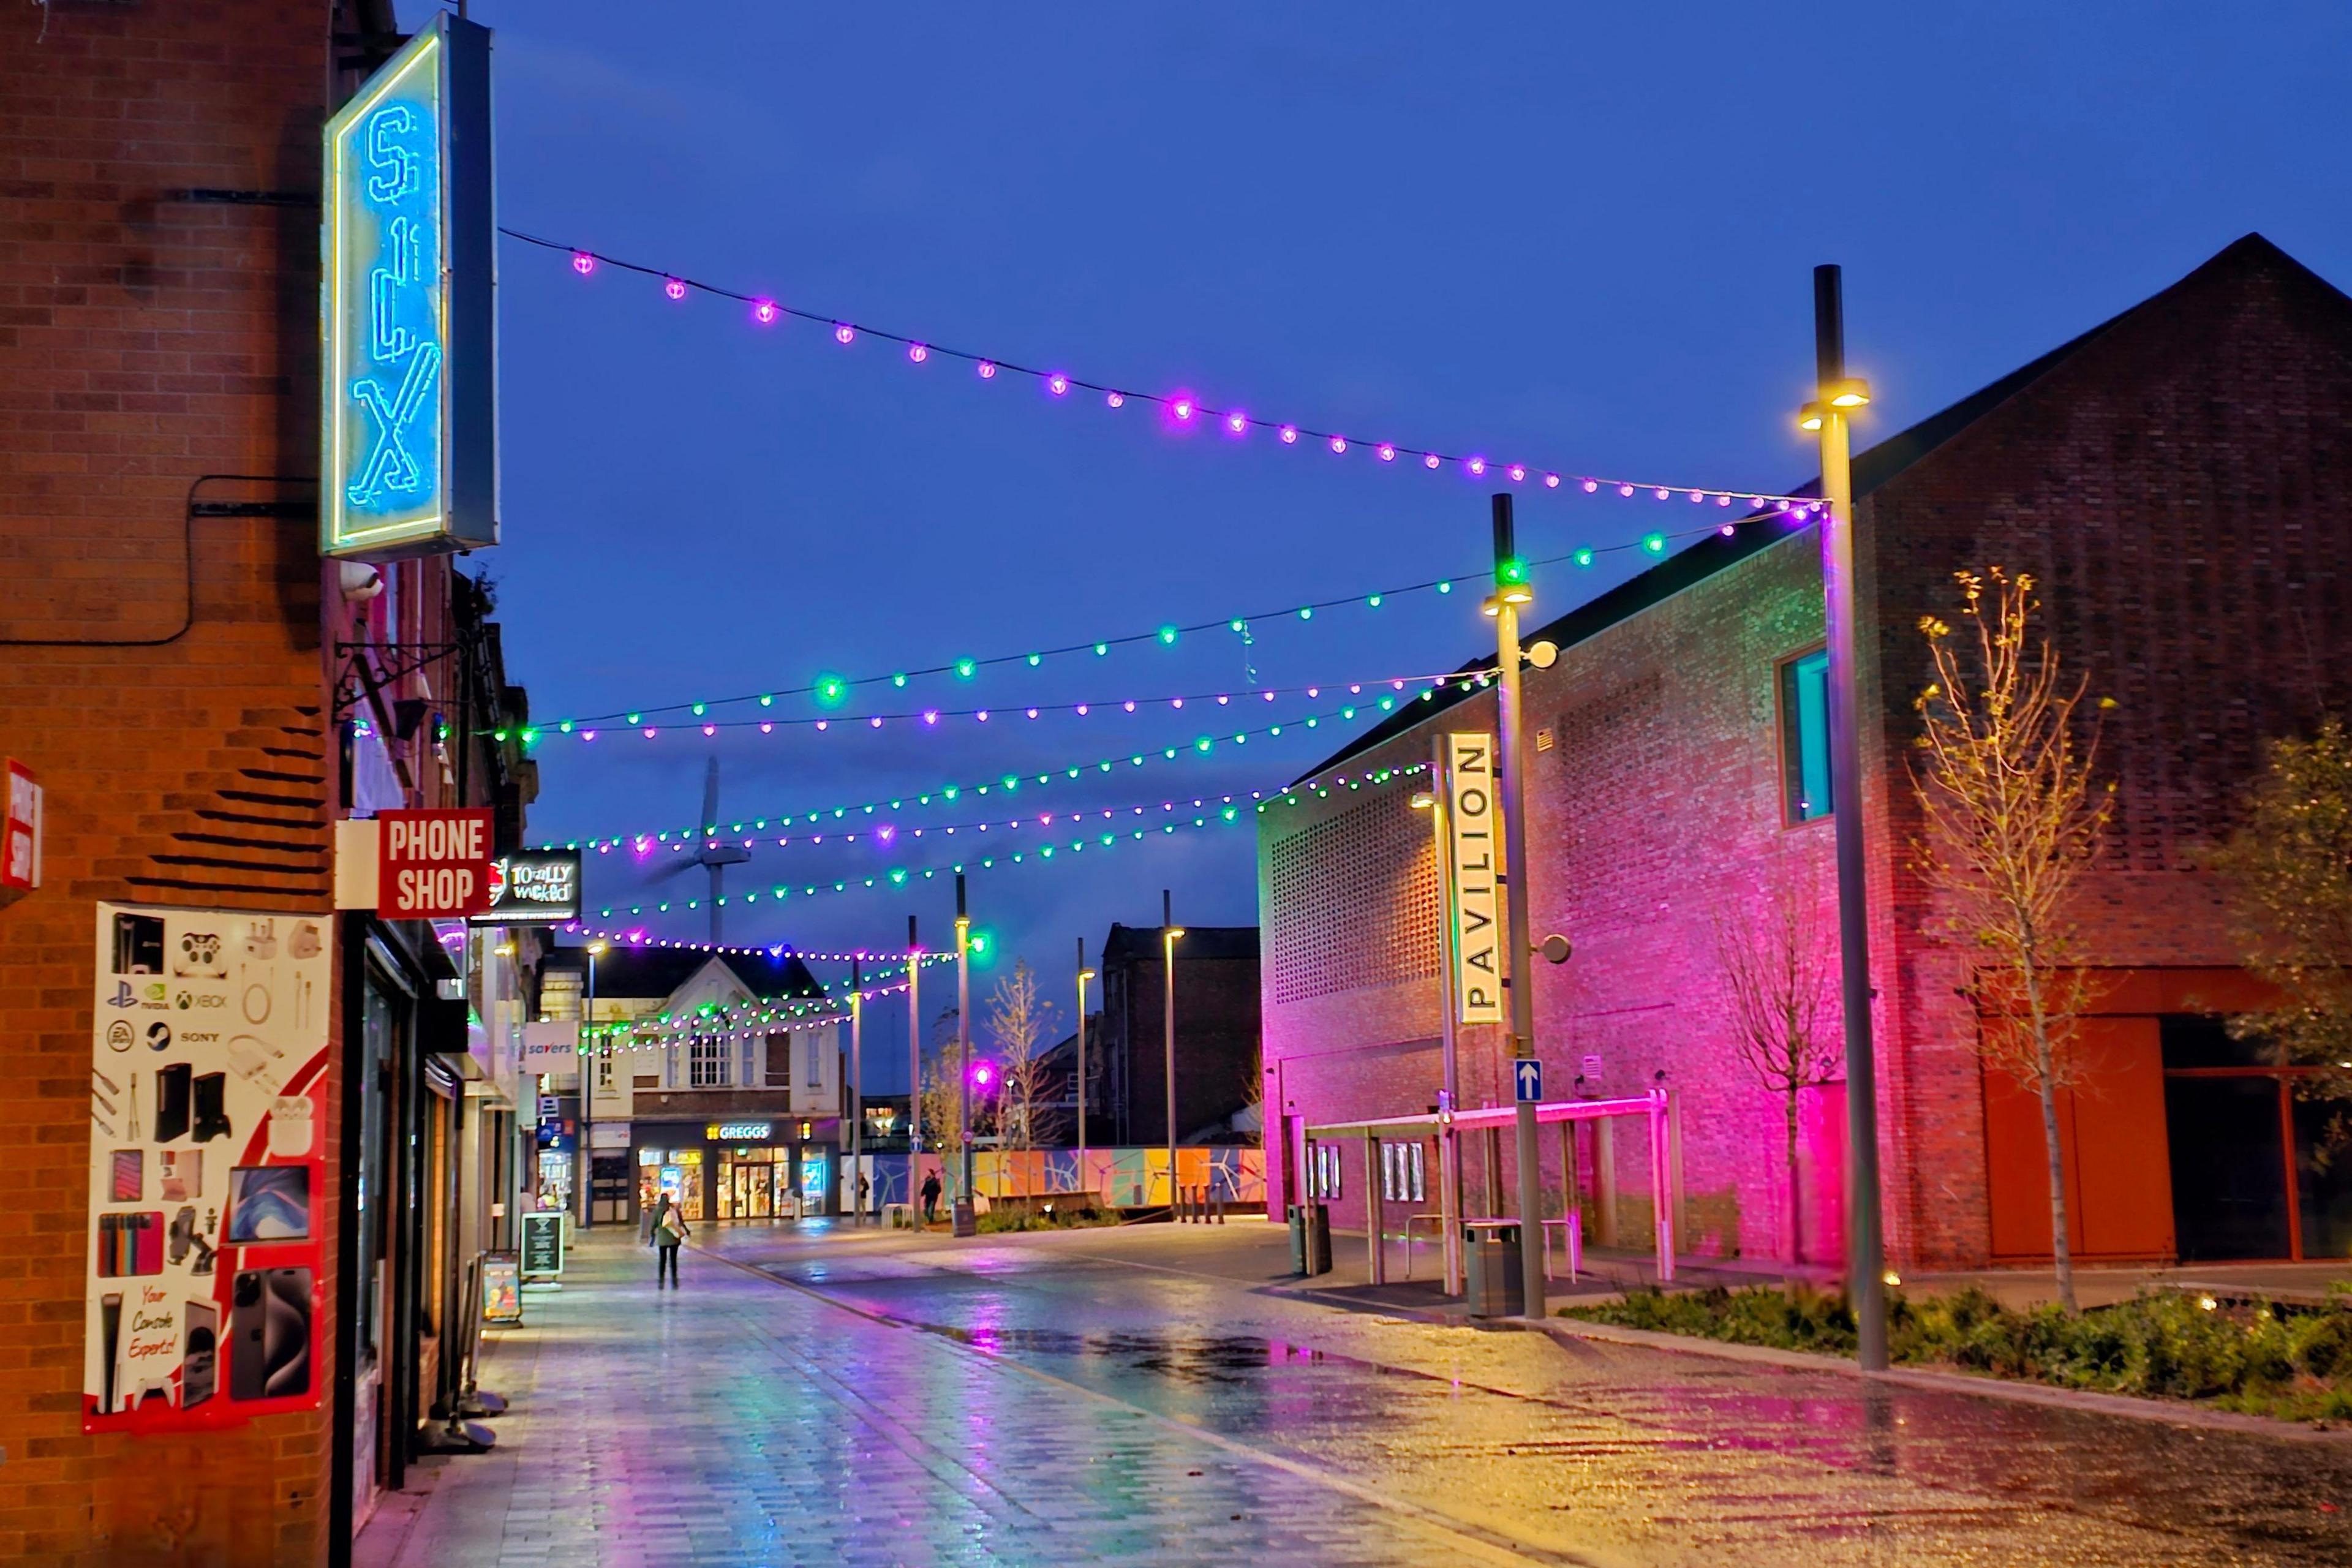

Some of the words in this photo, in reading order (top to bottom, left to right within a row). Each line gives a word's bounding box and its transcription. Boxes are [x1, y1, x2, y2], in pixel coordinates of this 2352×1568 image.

[389, 819, 484, 861] PHONE
[1457, 746, 1496, 1008] PAVILION
[397, 868, 474, 910] SHOP
[195, 995, 227, 1008] XBOX
[180, 1032, 220, 1042] SONY
[528, 1042, 572, 1054] savers
[719, 1125, 770, 1139] GREGGS
